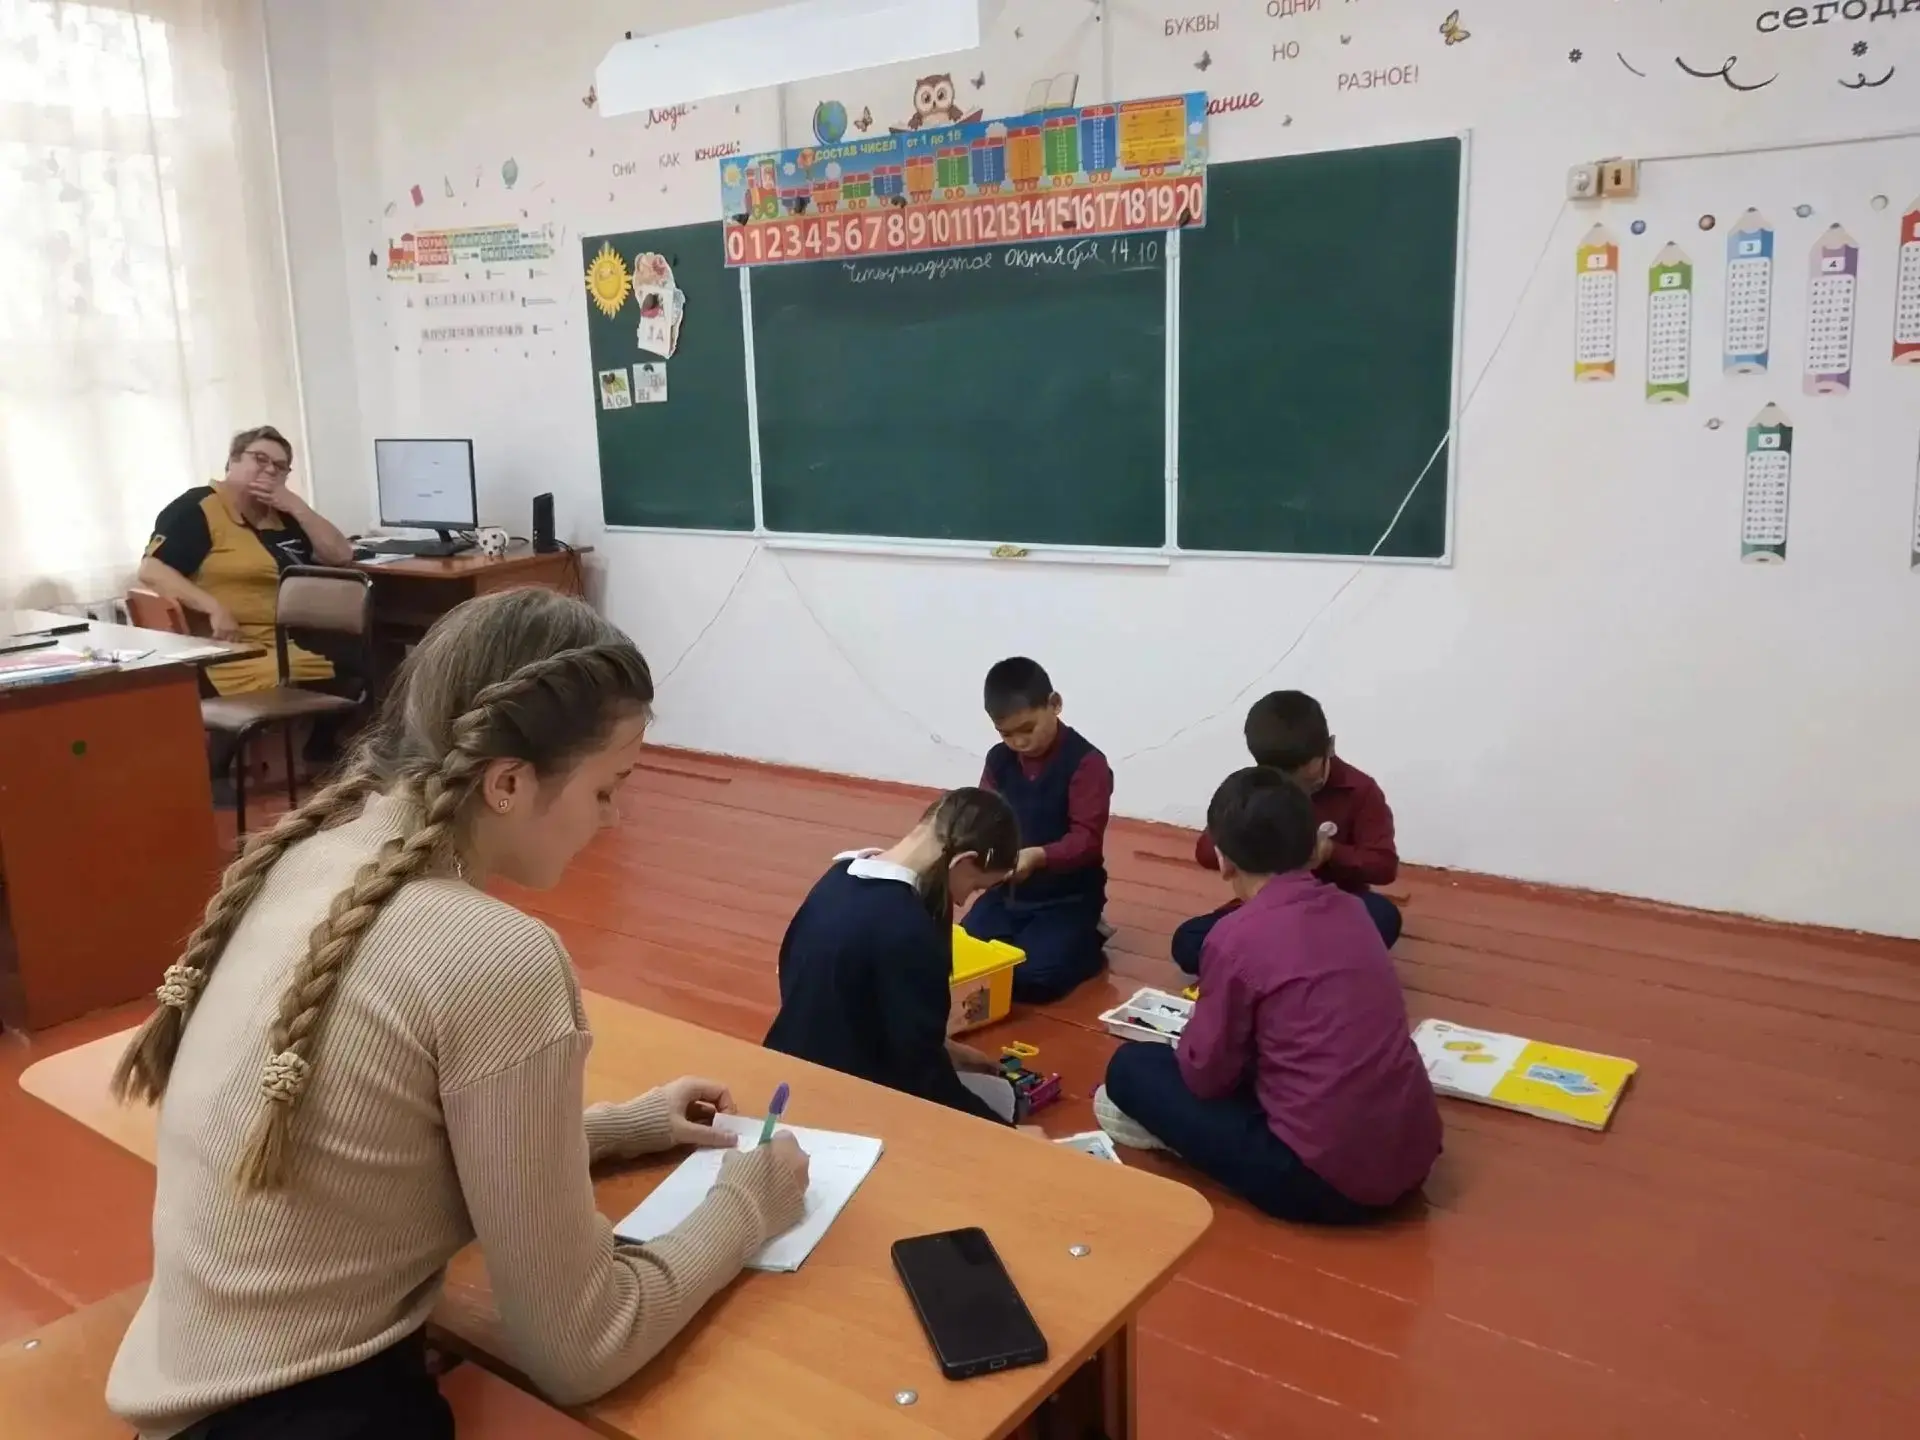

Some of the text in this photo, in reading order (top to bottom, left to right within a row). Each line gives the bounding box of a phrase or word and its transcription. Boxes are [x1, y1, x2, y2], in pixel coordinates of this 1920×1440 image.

[1165, 0, 1321, 36] БУКВЫ ОДНИ
[1272, 41, 1300, 62] НО
[1338, 65, 1419, 91] РАЗНОЕ!
[815, 145, 858, 161] СОСТАВ
[861, 140, 897, 153] ЧИСЕЛ
[906, 138, 918, 148] от
[930, 134, 944, 145] до
[612, 162, 636, 178] ОНИ
[659, 152, 681, 169] КАК
[728, 182, 1201, 261] 0 1 2 3 4 5 6 7 8 9 10 11 12 13 14 15 16 17 18 19 20
[1004, 239, 1105, 270] октября
